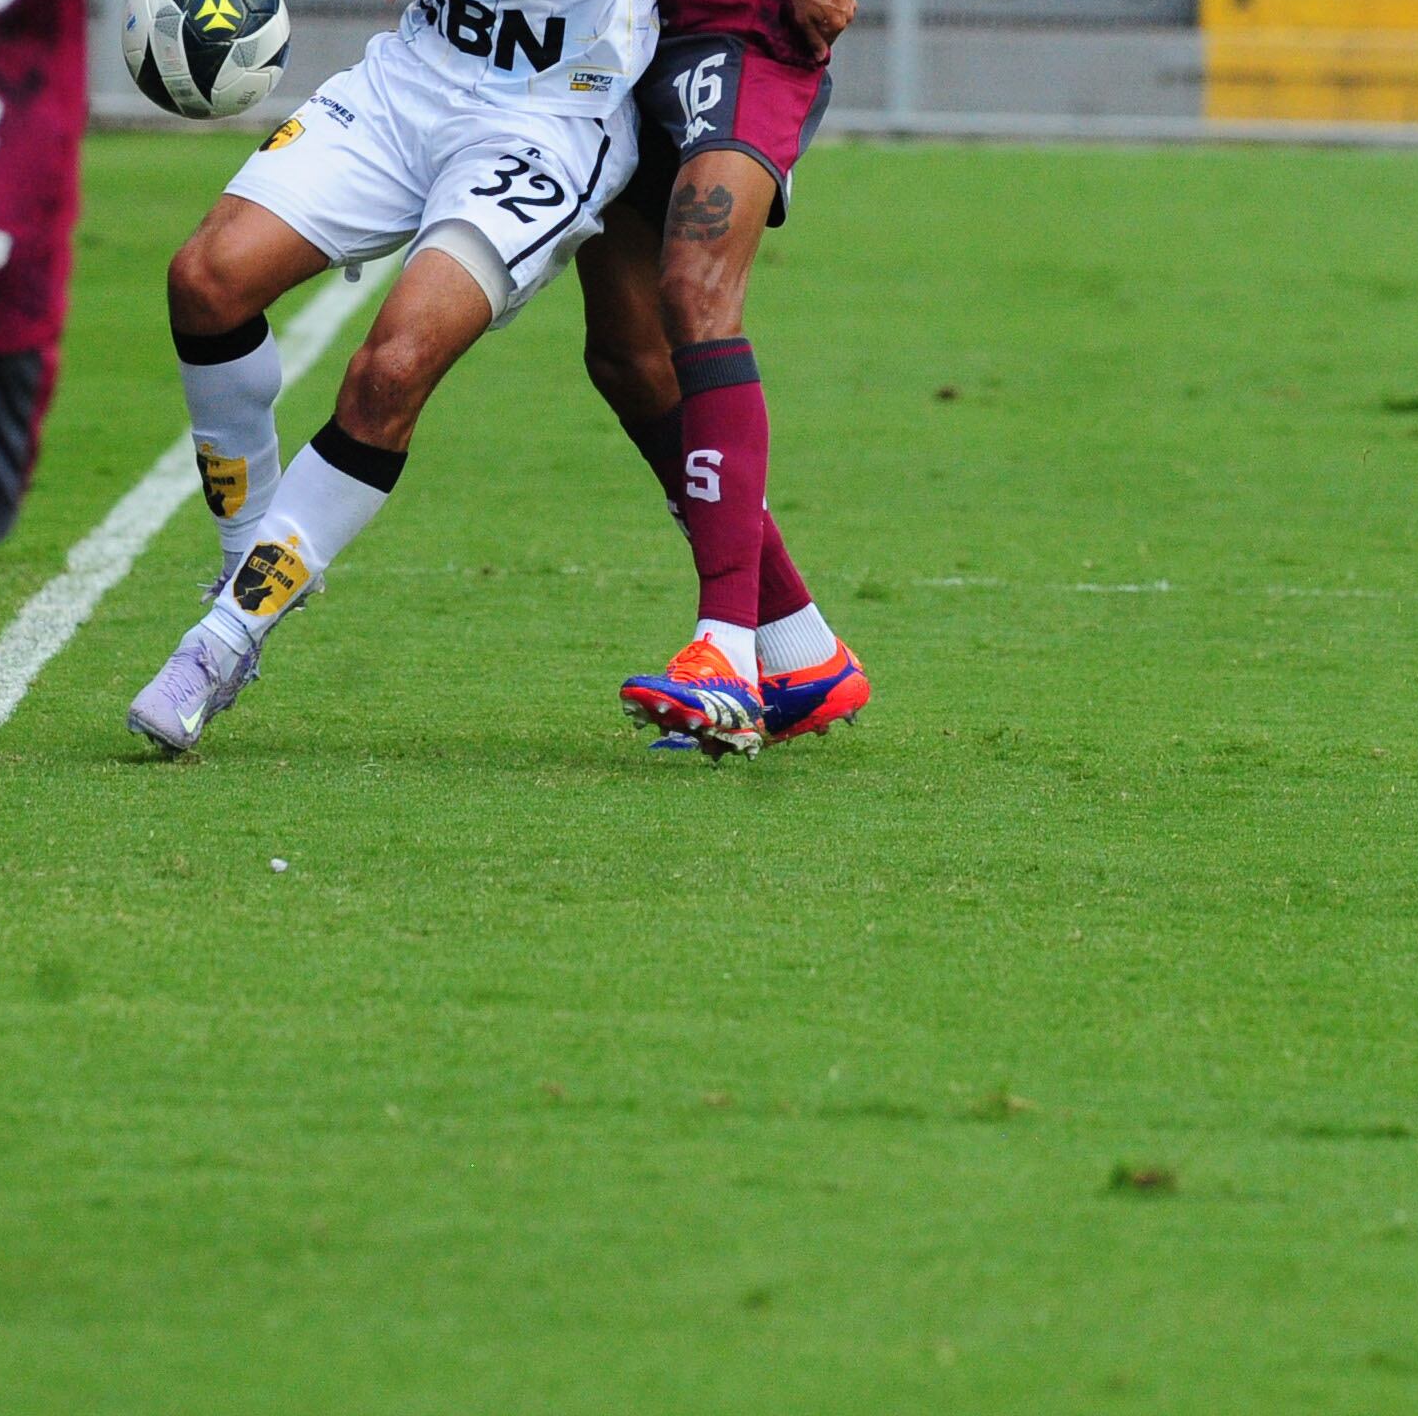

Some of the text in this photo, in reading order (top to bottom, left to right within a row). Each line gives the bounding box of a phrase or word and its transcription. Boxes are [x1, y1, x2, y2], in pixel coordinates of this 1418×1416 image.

[673, 52, 727, 122] 16
[470, 154, 566, 224] 32
[685, 449, 724, 503] S
